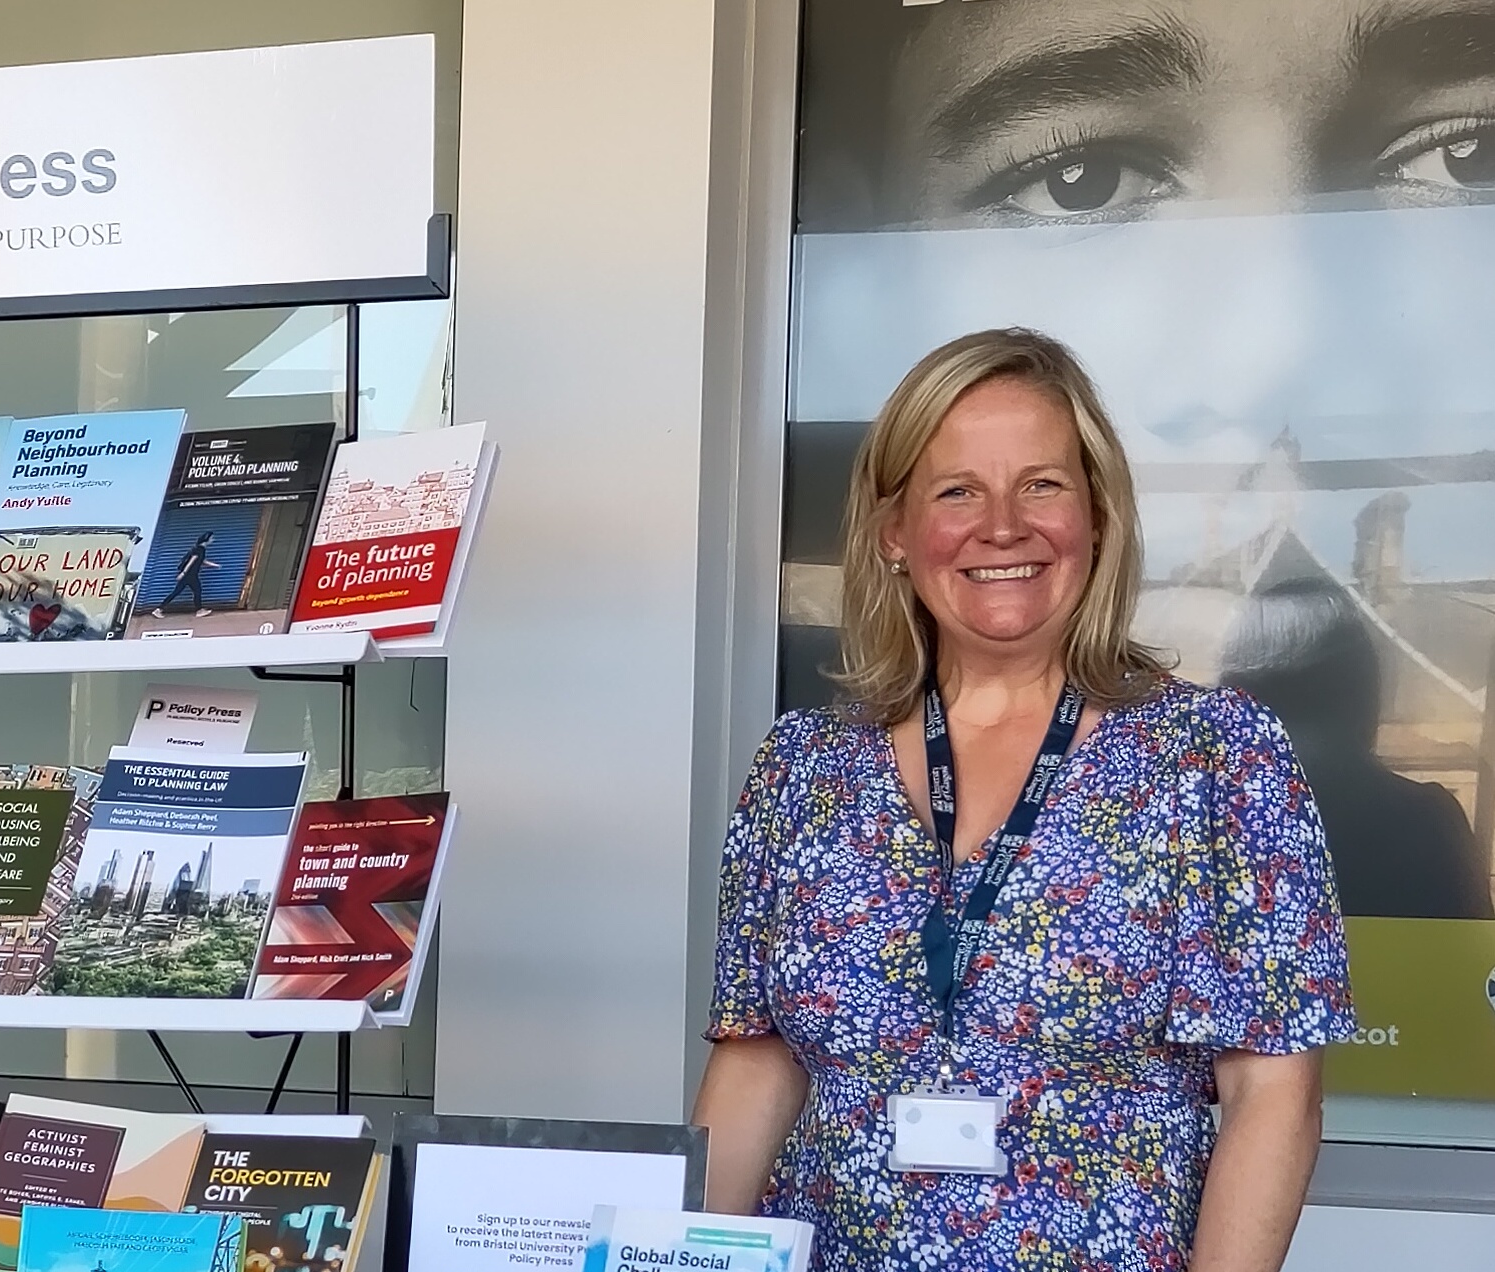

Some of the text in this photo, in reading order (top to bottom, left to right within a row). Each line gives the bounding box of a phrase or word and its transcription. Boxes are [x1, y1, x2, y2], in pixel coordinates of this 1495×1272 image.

[23, 425, 87, 445] Beyond
[17, 440, 151, 463] Neighbourhood
[12, 462, 88, 479] Planning
[1, 495, 72, 510] Andy Yuille
[0, 548, 123, 574] OUR LAND
[325, 542, 435, 569] The future
[317, 561, 435, 591] of planning
[54, 578, 115, 598] HOME
[168, 702, 242, 718] Policy Press
[124, 764, 230, 781] THE ESSENTIAL GUIDE
[133, 776, 228, 792] TO PLANNING LAW
[300, 852, 409, 871] town and country
[293, 873, 348, 892] planning
[27, 1128, 87, 1145] ACTIVIST
[23, 1141, 85, 1158] FEMINIST
[212, 1150, 250, 1167] THE
[4, 1151, 96, 1174] GEOGRAPHIES
[209, 1168, 331, 1187] FORGOTTEN
[205, 1185, 252, 1202] CITY
[455, 1237, 575, 1256] from Bristol University
[509, 1252, 573, 1268] Policy Press
[619, 1245, 731, 1271] Global Social
